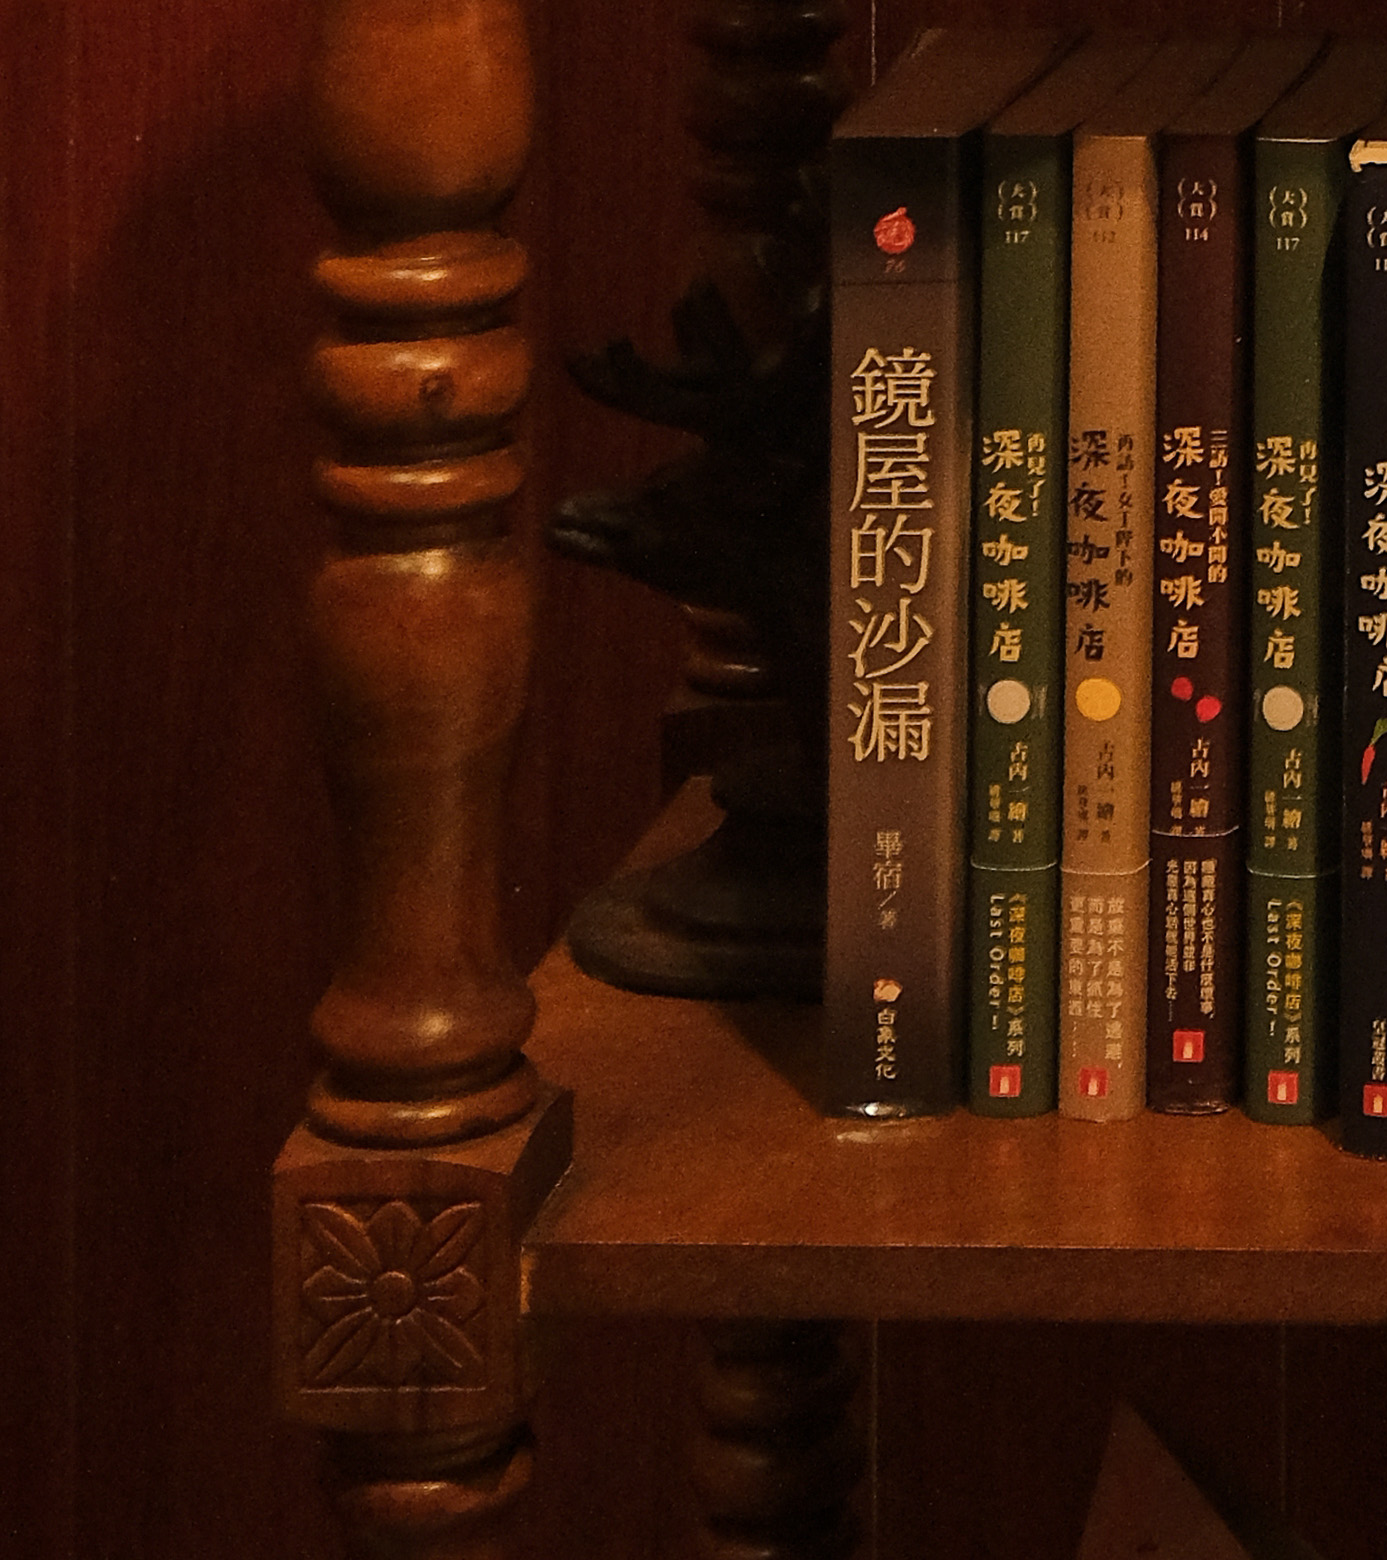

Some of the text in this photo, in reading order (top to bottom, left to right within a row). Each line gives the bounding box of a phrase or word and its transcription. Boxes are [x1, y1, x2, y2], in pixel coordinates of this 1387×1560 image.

[1184, 227, 1210, 242] 114
[1276, 236, 1301, 252] 117
[847, 345, 939, 765] 鏡屋的沙漏
[981, 428, 1030, 664] 深夜咖啡店
[1067, 429, 1112, 664] 深夜咖啡店
[1159, 425, 1206, 660] 深夜咖啡店
[1255, 434, 1302, 670] 深夜咖啡店
[989, 894, 1006, 940] Last
[1266, 898, 1283, 947] Last
[873, 1006, 898, 1081] 白象文化
